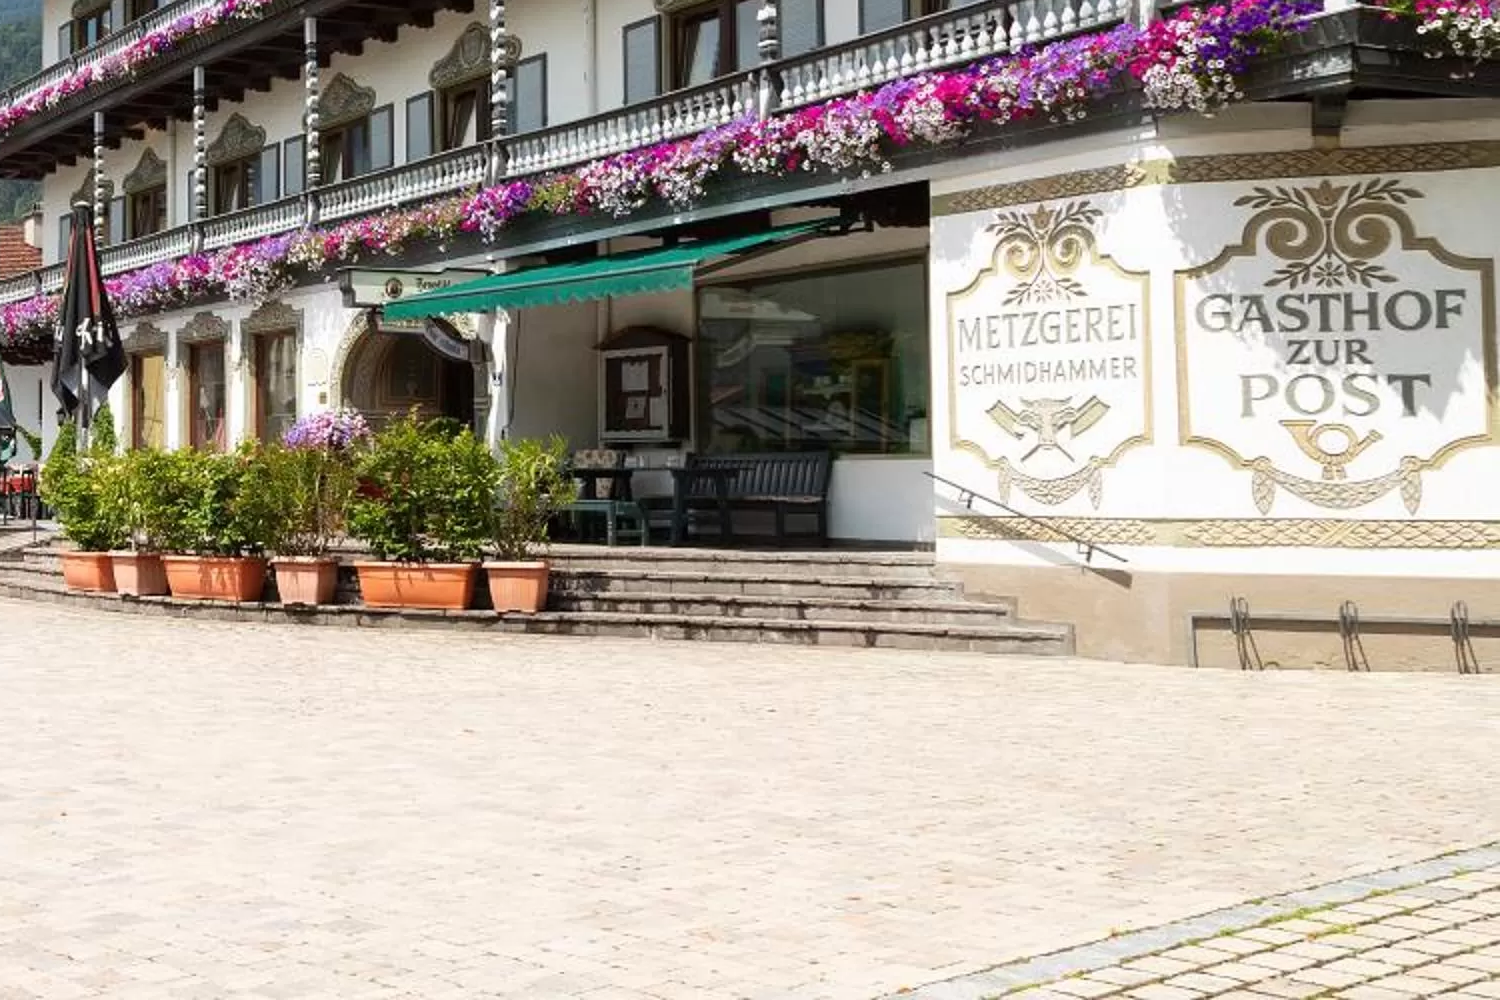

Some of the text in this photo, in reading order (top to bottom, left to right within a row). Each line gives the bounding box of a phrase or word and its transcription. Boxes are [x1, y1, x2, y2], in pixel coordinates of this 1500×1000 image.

[958, 303, 1137, 352] METZGEREI
[1195, 289, 1466, 333] GASTHOF
[959, 356, 1137, 386] SCHMIDHAMMER
[1286, 339, 1374, 366] ZUR
[1239, 373, 1431, 418] POST
